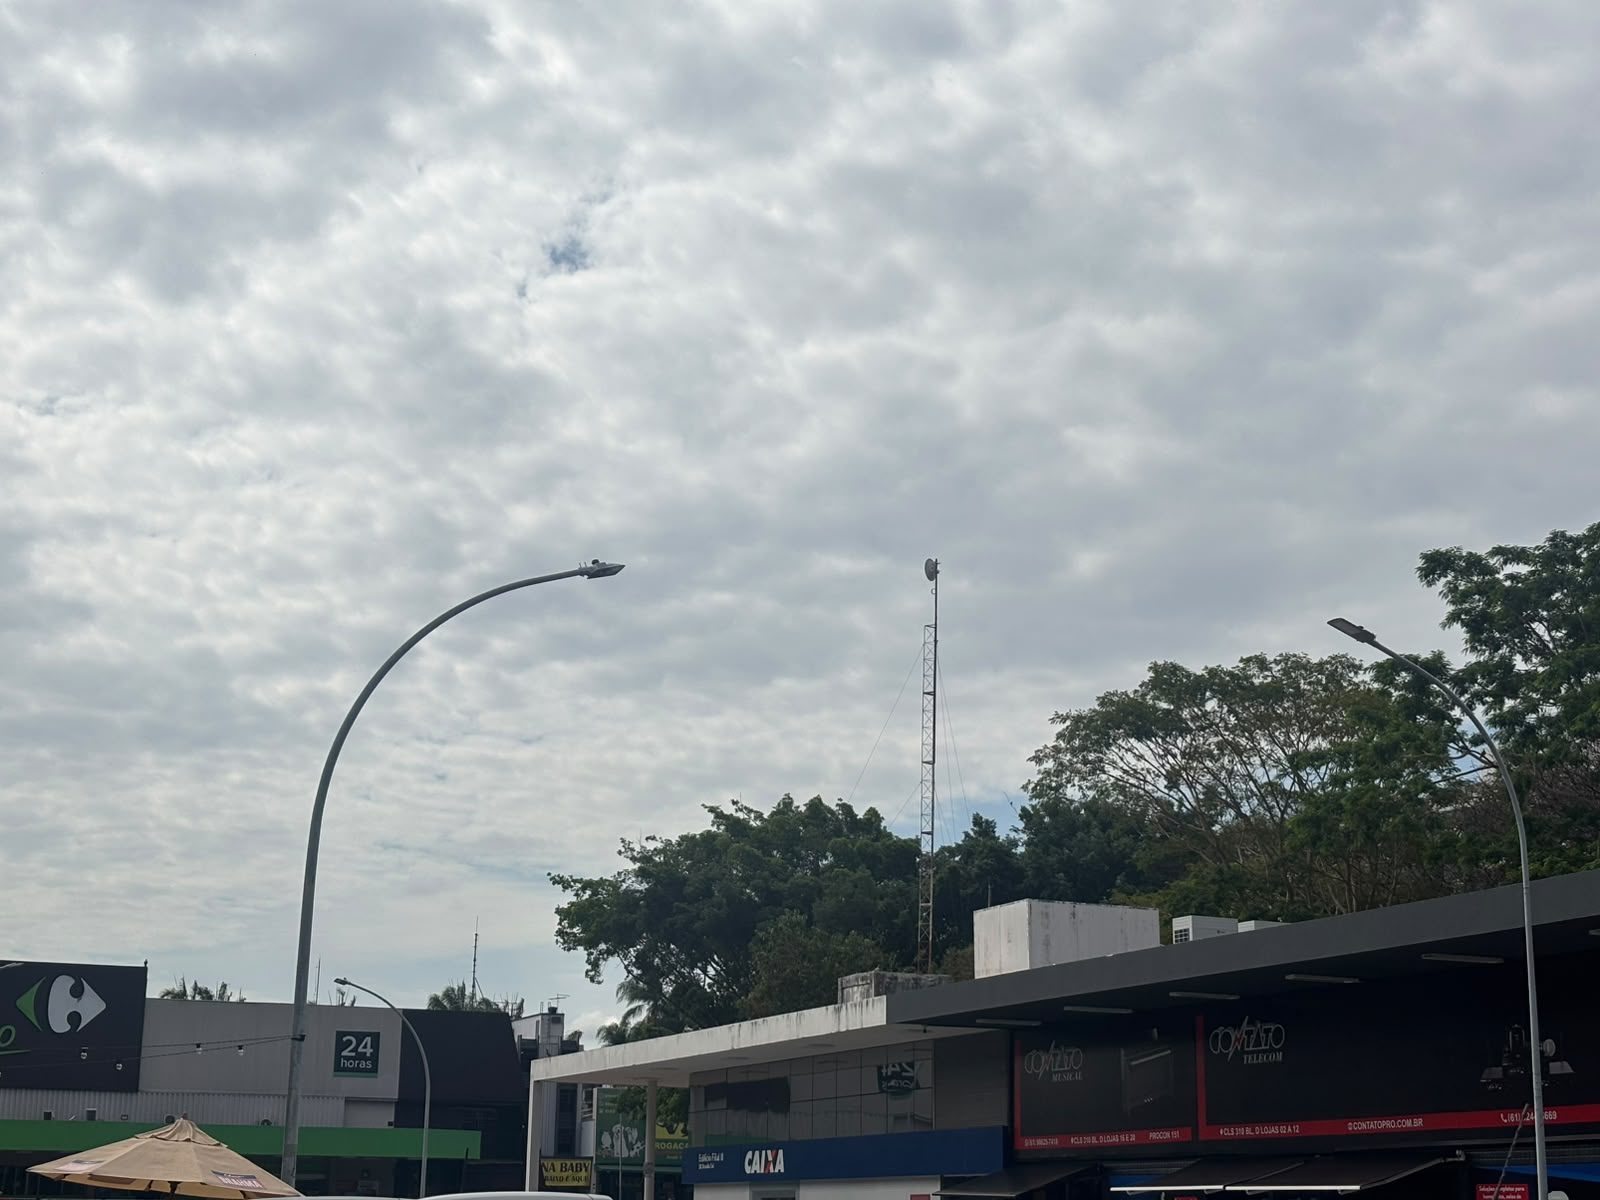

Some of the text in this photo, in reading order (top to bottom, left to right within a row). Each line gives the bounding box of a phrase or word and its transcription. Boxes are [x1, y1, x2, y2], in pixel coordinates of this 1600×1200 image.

[1209, 1015, 1285, 1062] CONTATO
[341, 1036, 373, 1057] 24
[340, 1057, 372, 1069] horas
[1243, 1052, 1283, 1065] TELECOM
[1052, 1072, 1083, 1083] MUSICAL
[1508, 1112, 1521, 1123] (61)
[1353, 1118, 1424, 1130] CONTATOPRO.COM.BR
[1260, 1126, 1279, 1135] LOJAS
[560, 1162, 590, 1173] BABY
[744, 1149, 785, 1175] CAIXA
